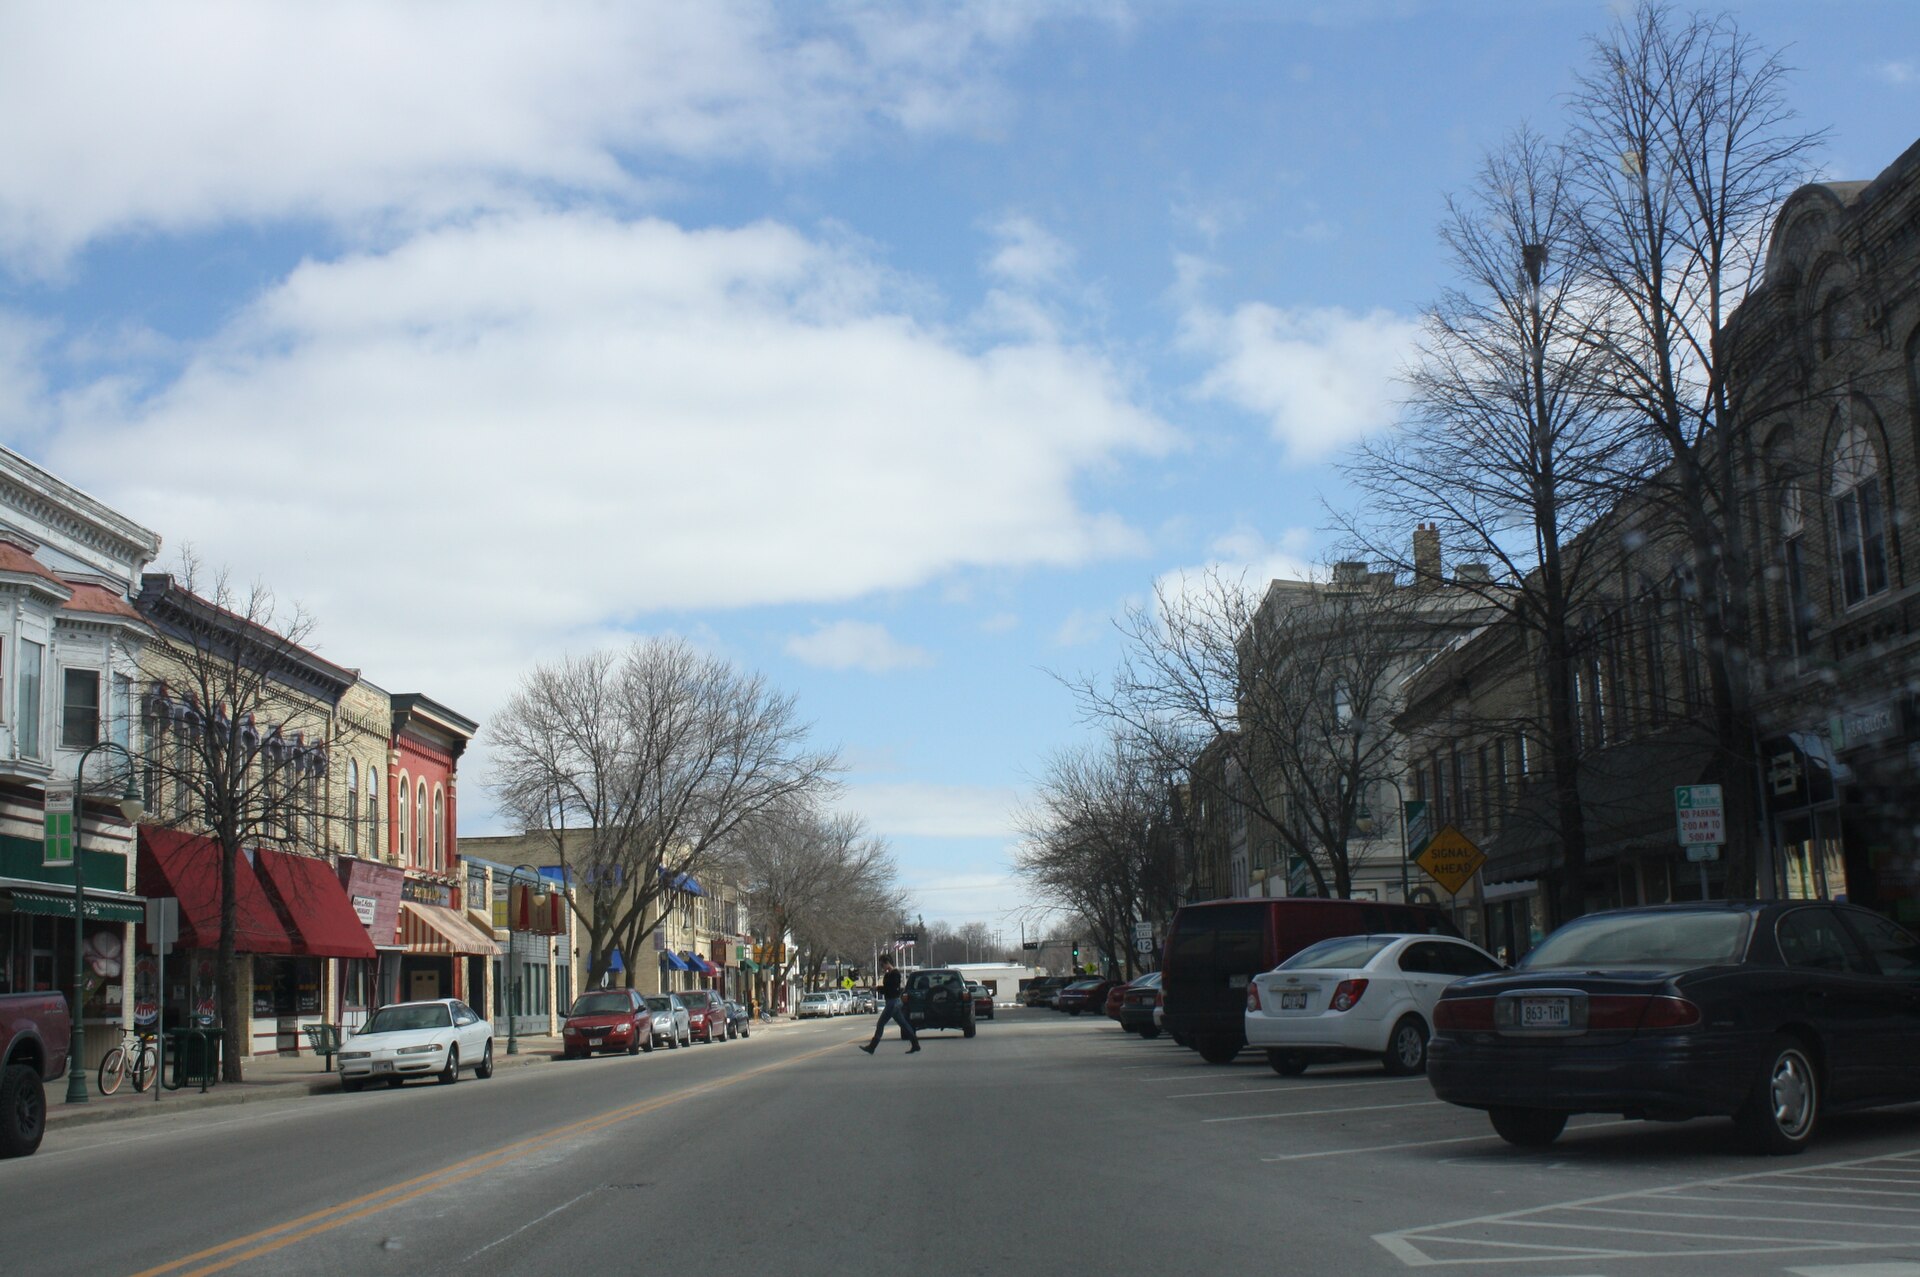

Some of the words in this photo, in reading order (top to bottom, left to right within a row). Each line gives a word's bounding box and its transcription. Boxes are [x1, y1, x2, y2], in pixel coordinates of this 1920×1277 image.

[1864, 710, 1893, 733] BLOCK
[1679, 790, 1690, 807] 2
[1691, 797, 1721, 806] PARKING
[1680, 810, 1689, 818] NO
[1692, 809, 1721, 818] PARKING
[1682, 822, 1697, 830] 2:00
[1698, 821, 1709, 830] AM
[1712, 820, 1721, 829] TO
[1688, 833, 1704, 841] 5:00
[1705, 832, 1715, 841] AM
[1431, 848, 1471, 859] SIGNAL
[1433, 862, 1472, 874] AHEAD
[1140, 941, 1151, 950] 12
